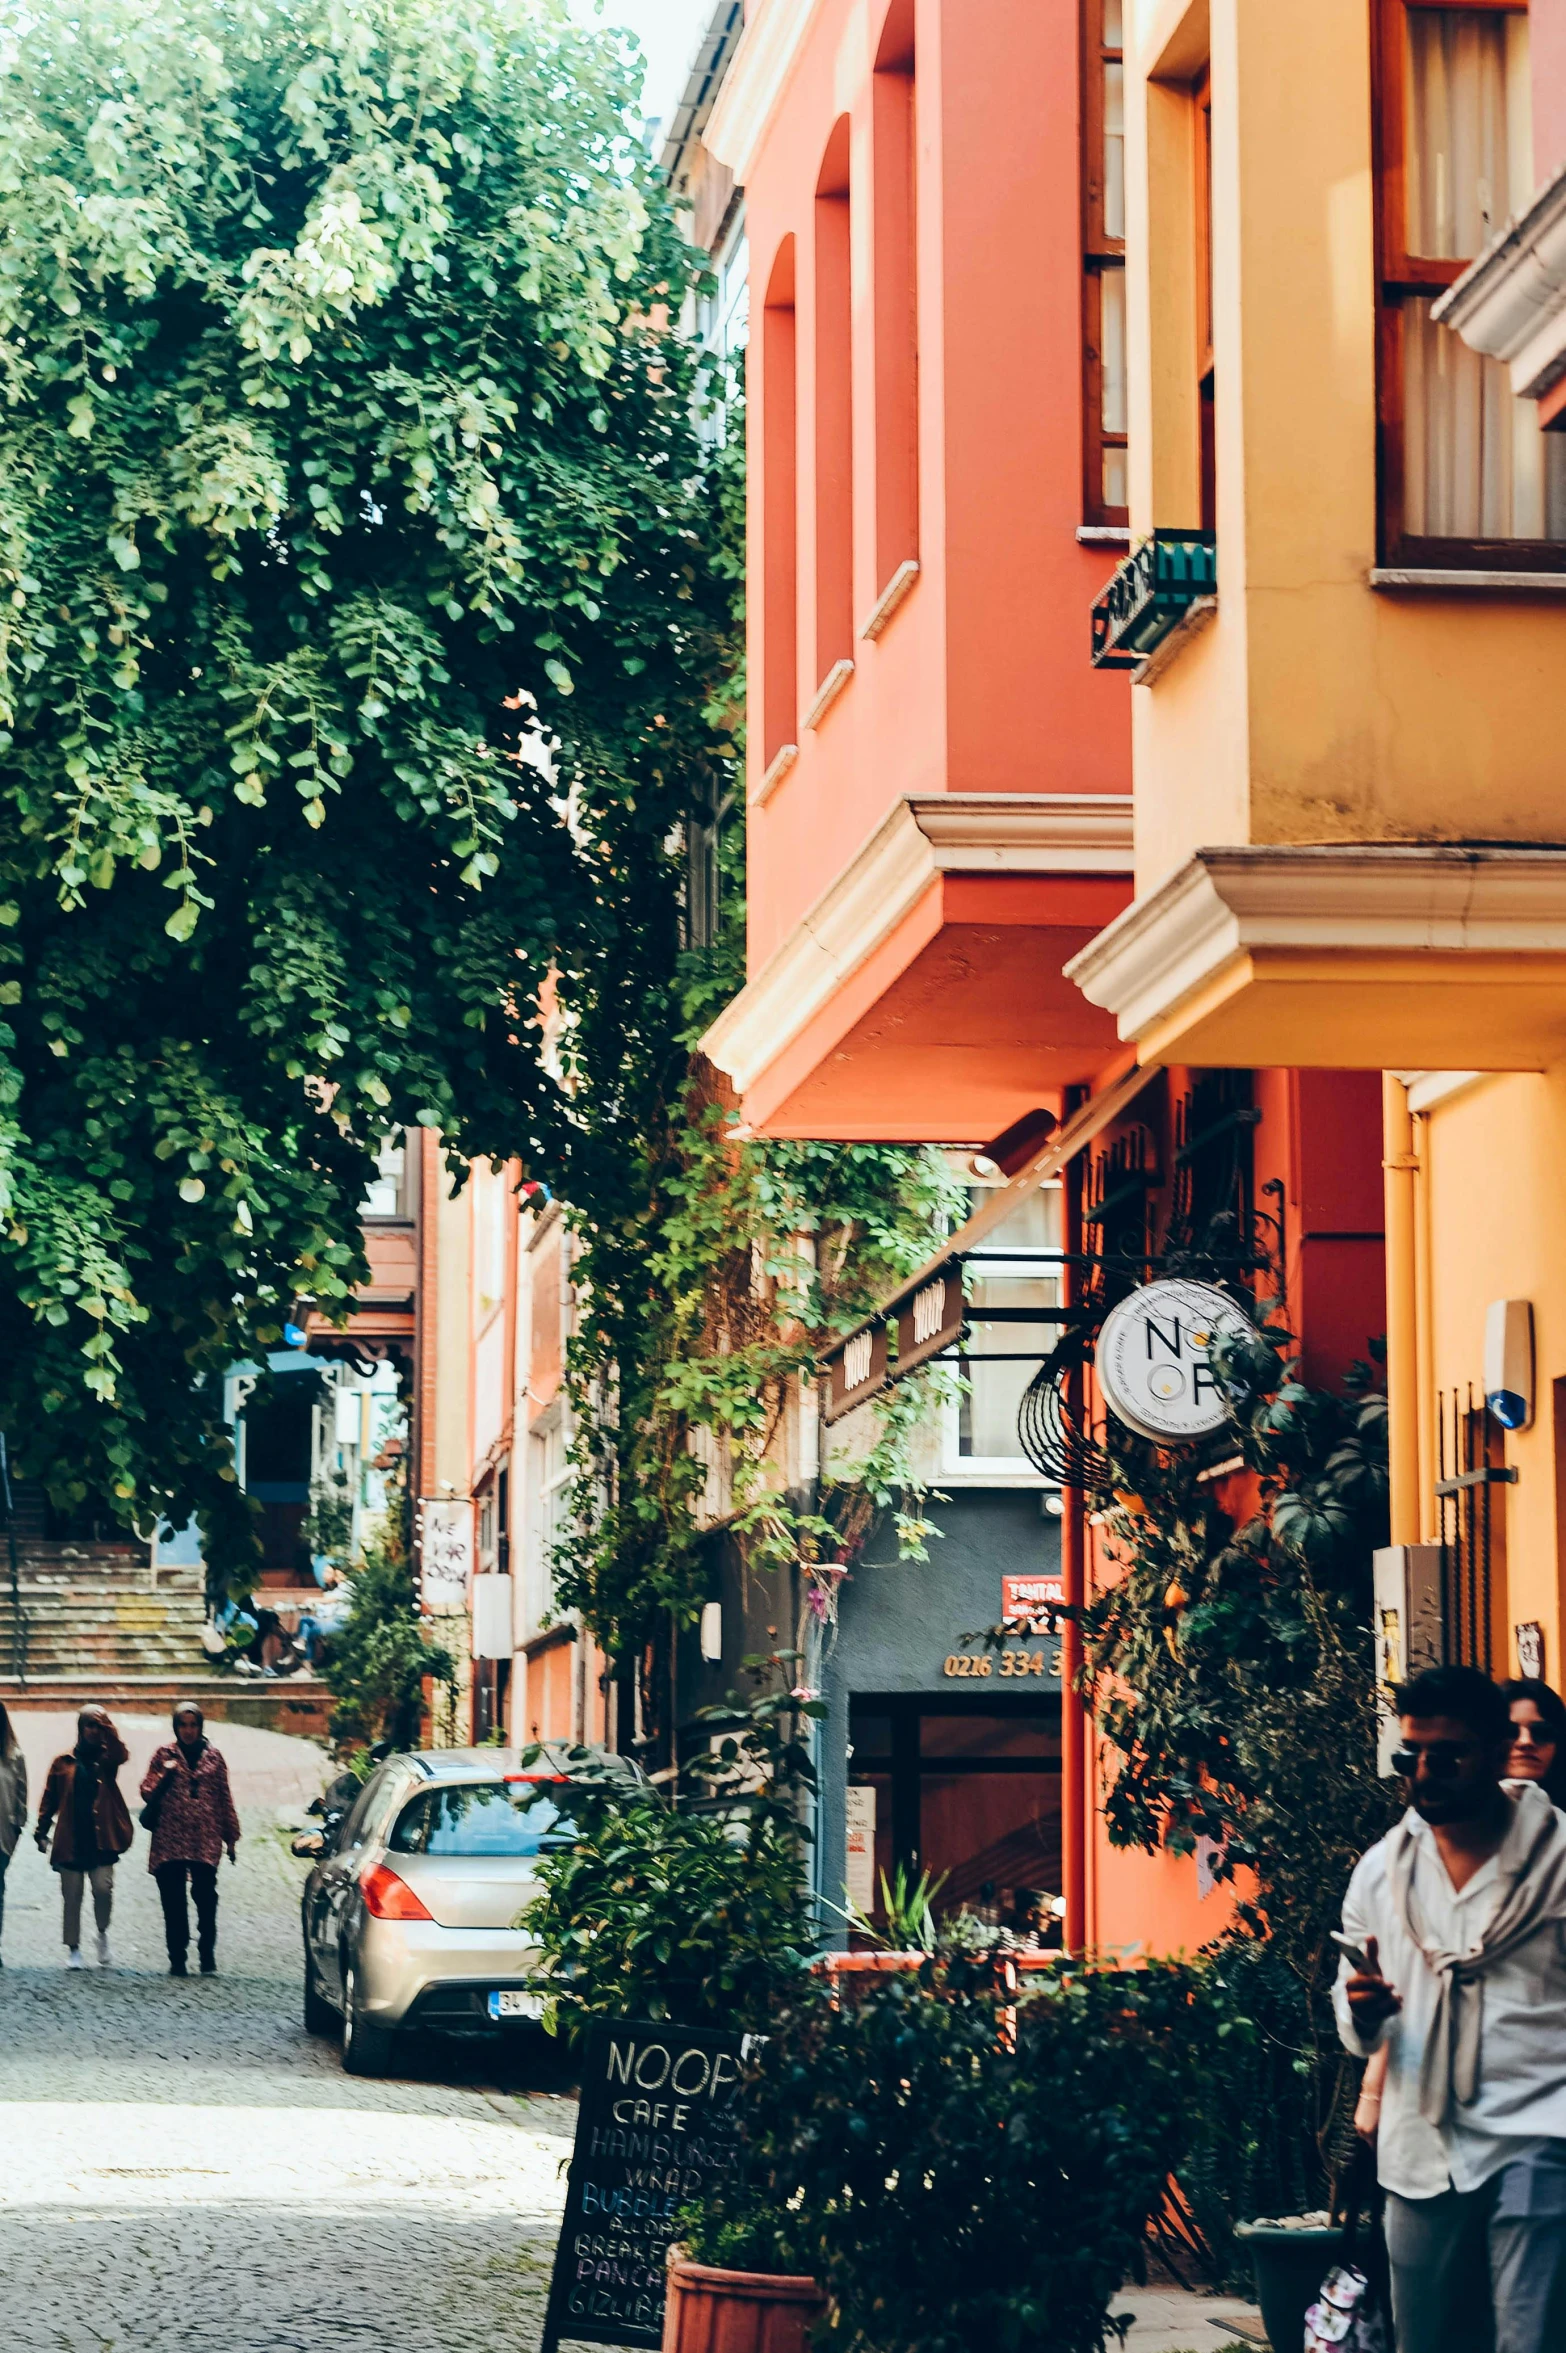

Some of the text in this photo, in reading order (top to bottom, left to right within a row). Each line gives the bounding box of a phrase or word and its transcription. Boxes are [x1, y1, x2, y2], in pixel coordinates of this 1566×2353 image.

[944, 1655, 993, 1677] 0216
[999, 1650, 1045, 1677] 334
[612, 2099, 692, 2131] CAFE
[625, 2165, 702, 2197] WRAP
[581, 2181, 676, 2217] BUBBLE
[609, 2216, 640, 2234] ALL
